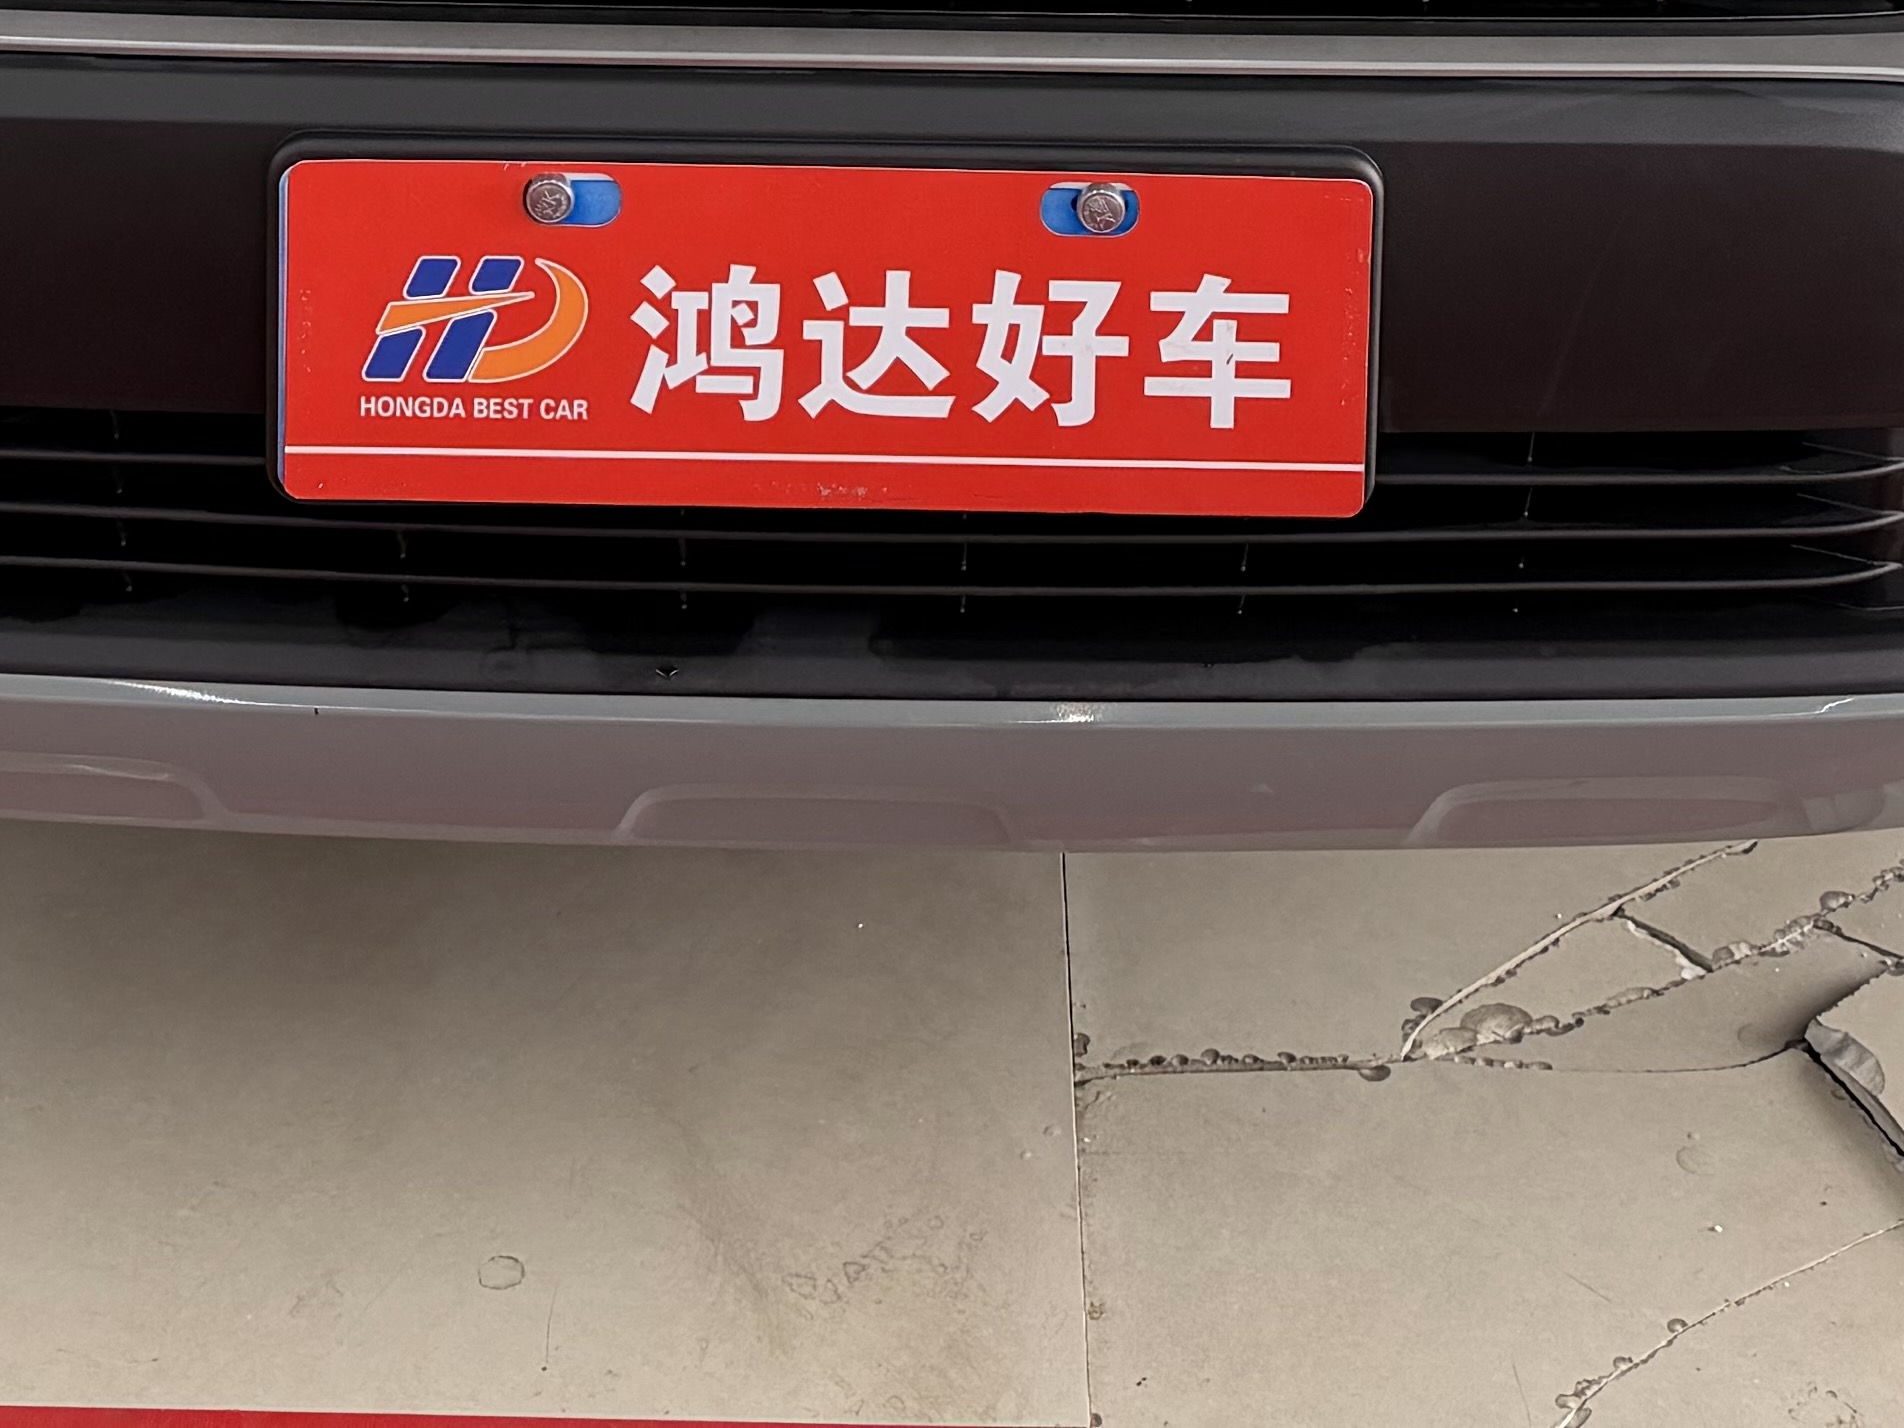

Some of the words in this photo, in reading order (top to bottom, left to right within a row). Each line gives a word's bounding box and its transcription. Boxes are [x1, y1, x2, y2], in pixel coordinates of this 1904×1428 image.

[630, 264, 1293, 429] 鸿达好车
[358, 396, 467, 418] HONGDA
[472, 398, 533, 420] BEST
[538, 399, 589, 421] CAR
